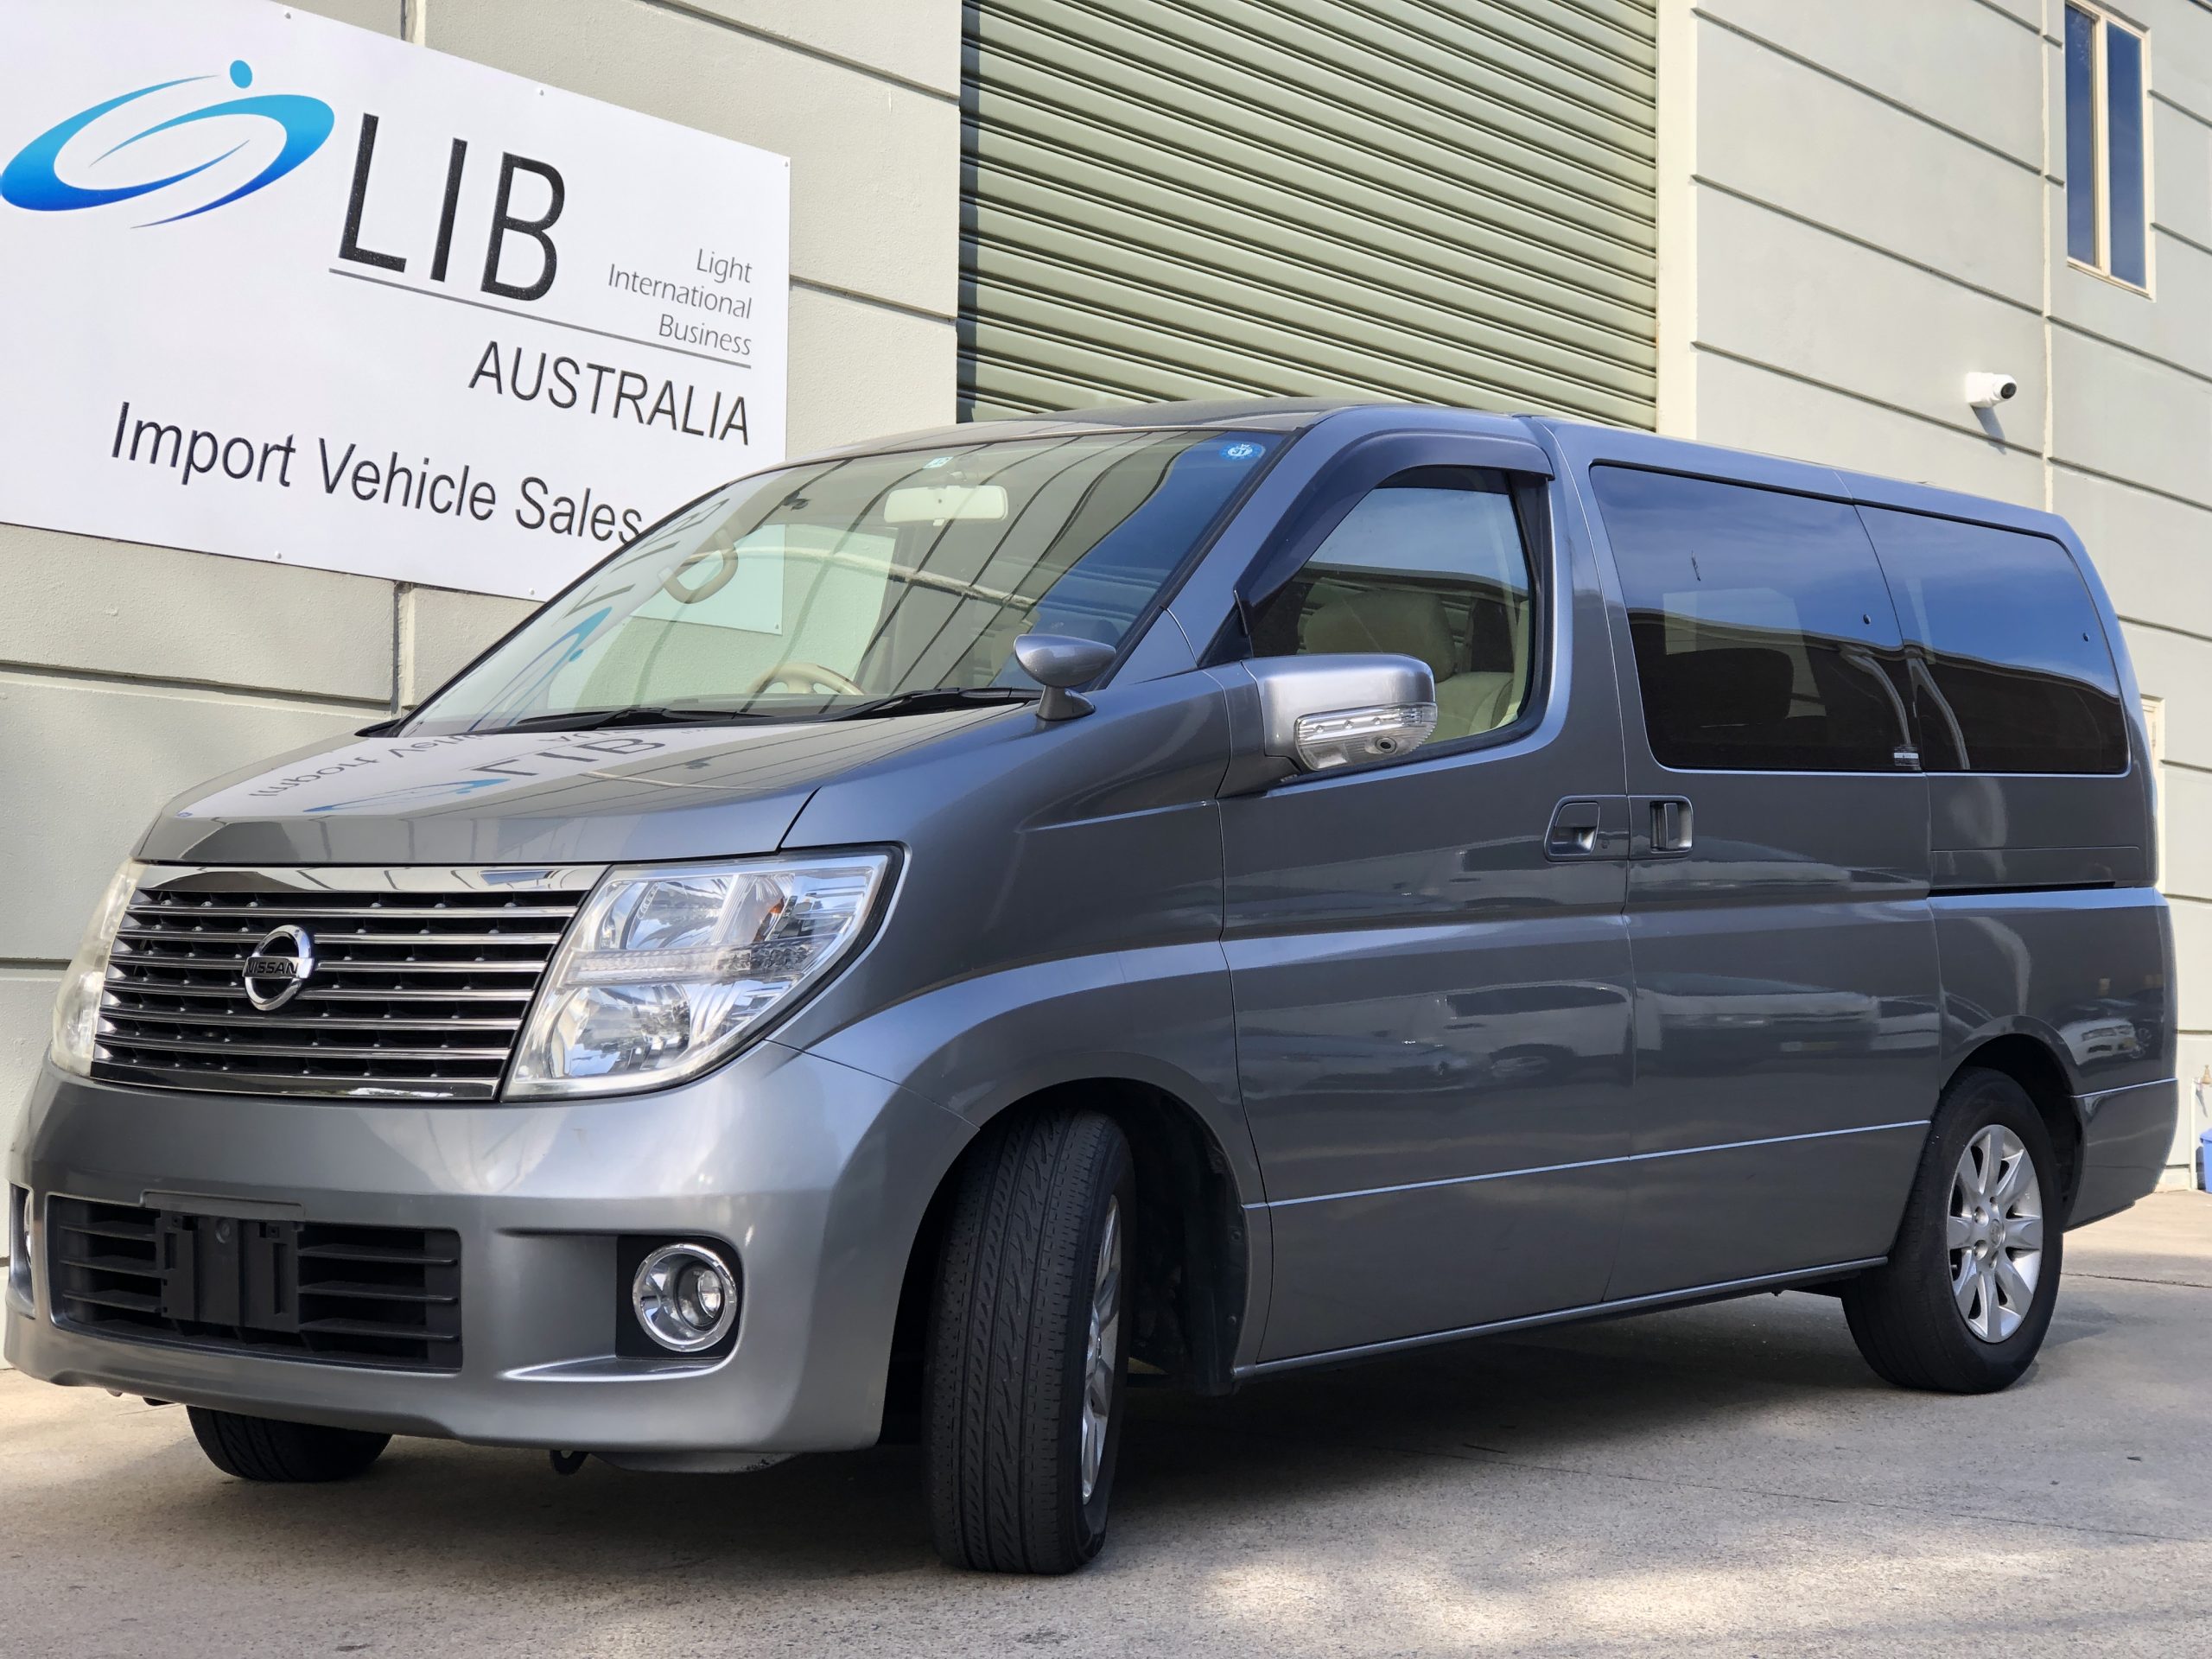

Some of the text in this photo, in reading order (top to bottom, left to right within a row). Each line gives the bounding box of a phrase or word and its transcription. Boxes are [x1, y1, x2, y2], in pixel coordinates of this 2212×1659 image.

[339, 113, 565, 301] LIB
[608, 264, 753, 319] International
[696, 248, 753, 283] Light
[658, 314, 752, 356] Business
[467, 340, 748, 446] AUSTRALIA
[111, 402, 642, 544] Import Vehicle Sales
[245, 961, 299, 975] NISSAN
